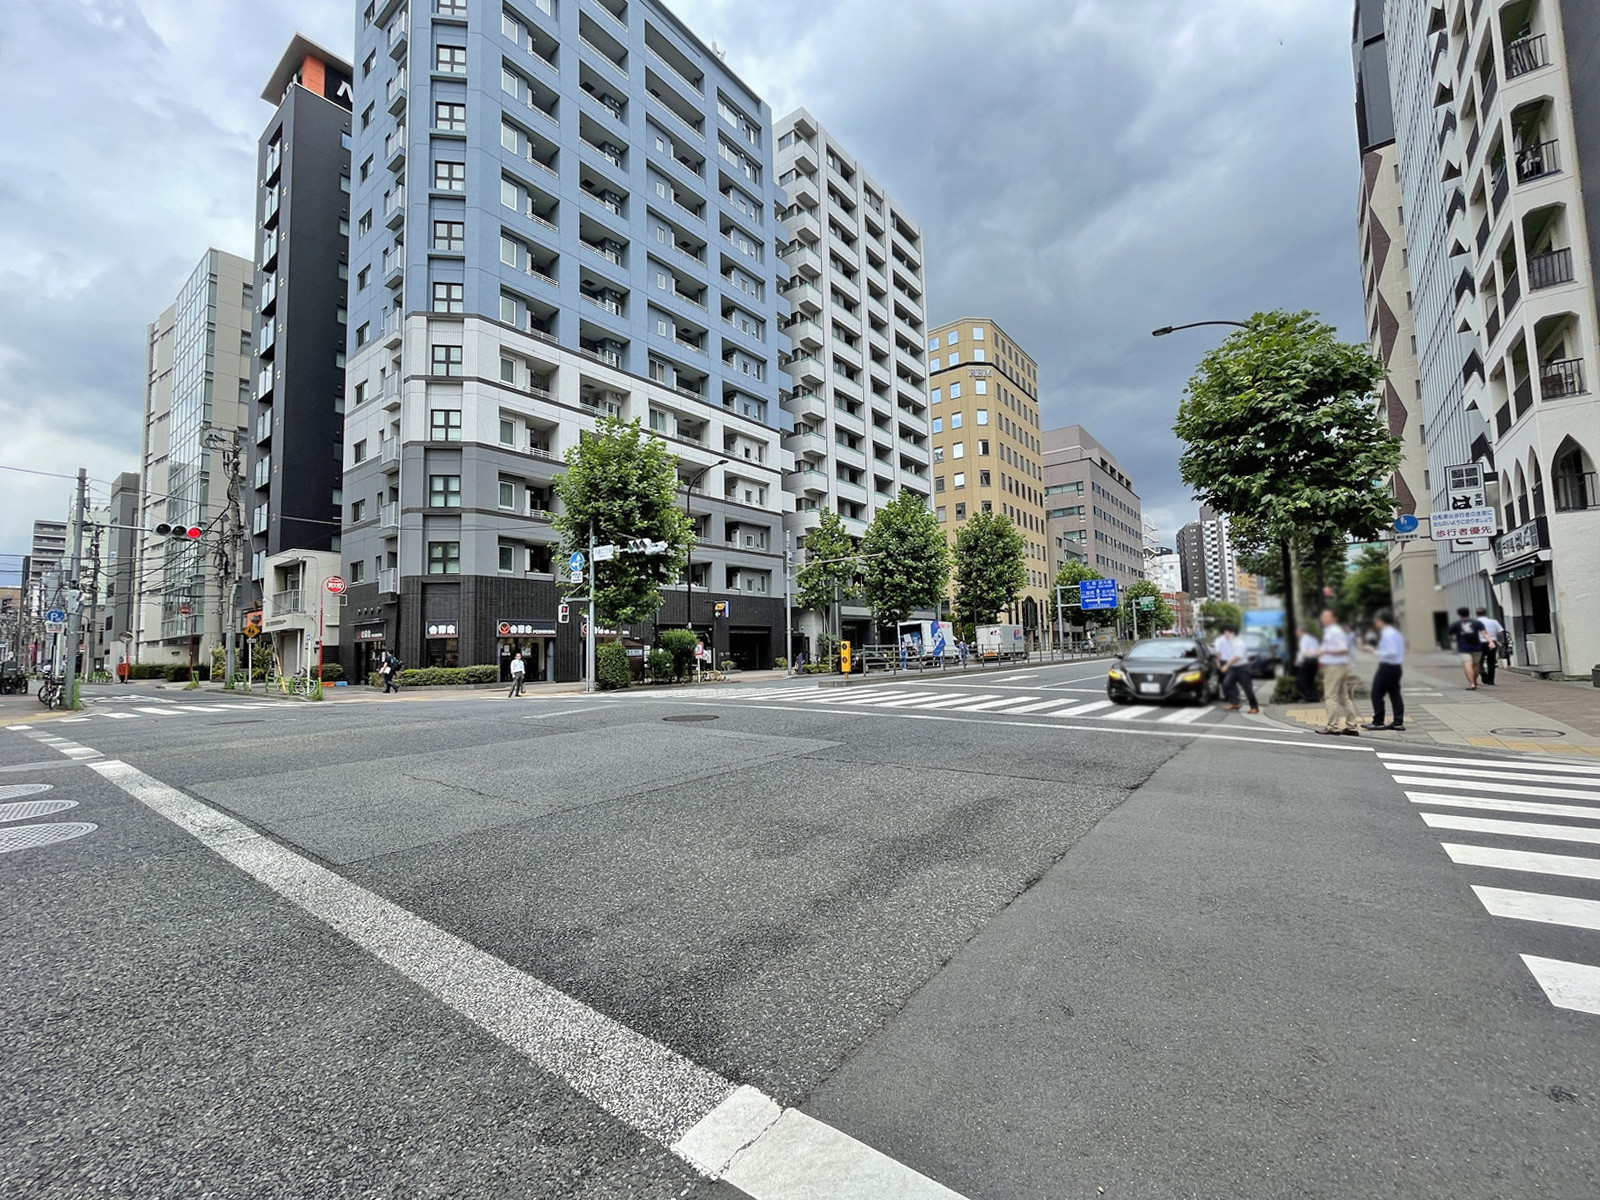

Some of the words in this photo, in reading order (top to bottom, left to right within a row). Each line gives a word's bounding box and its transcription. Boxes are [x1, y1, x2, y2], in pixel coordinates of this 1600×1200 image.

[1436, 526, 1492, 537] 歩行者優先
